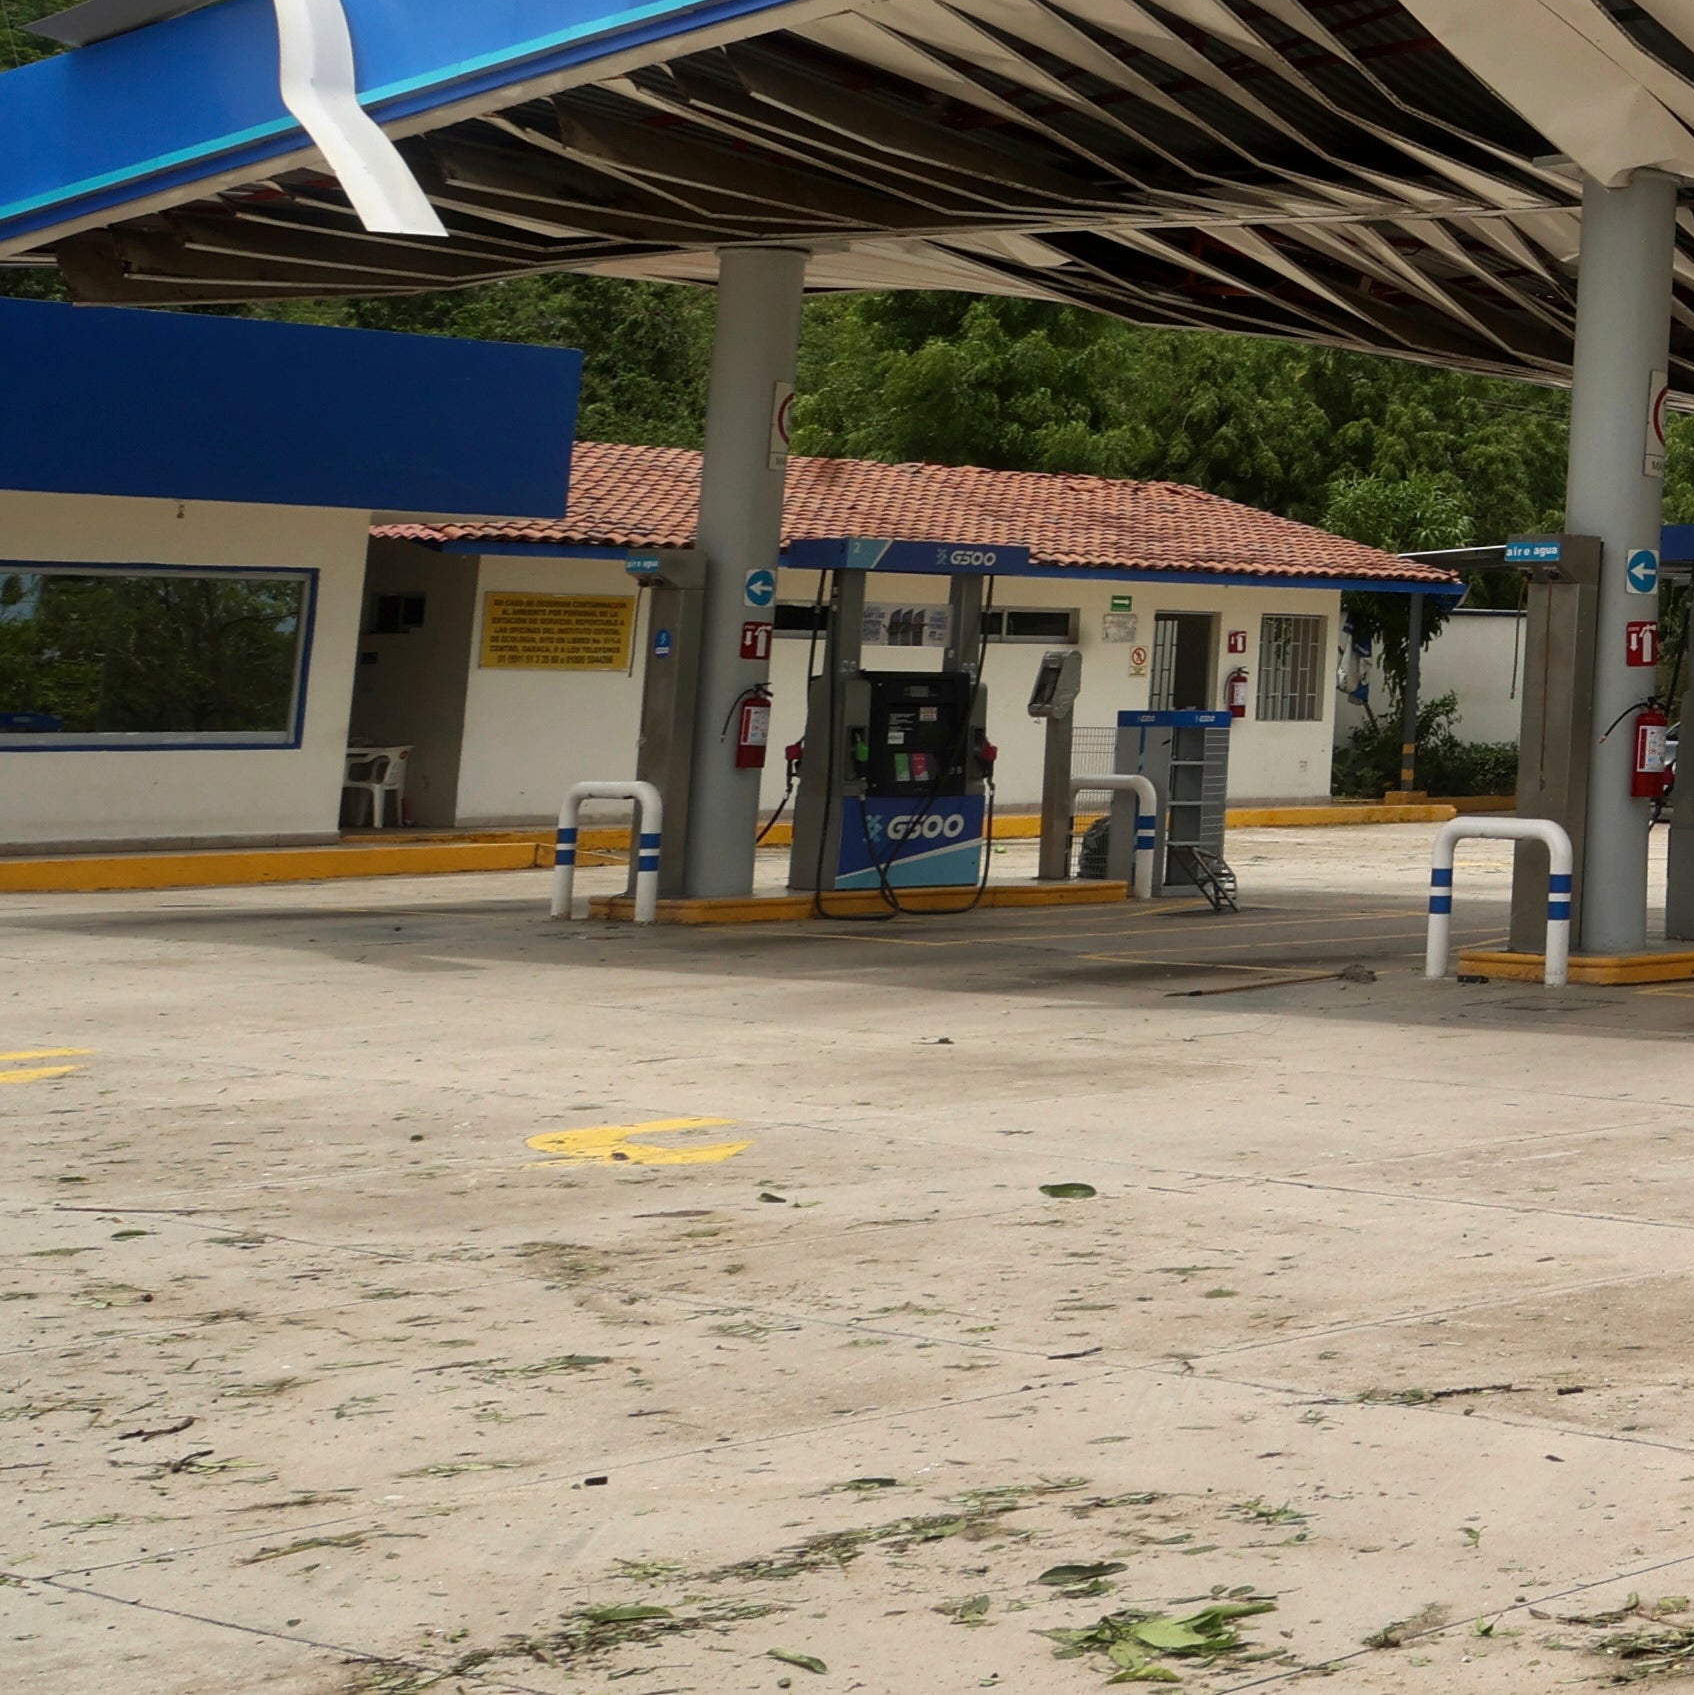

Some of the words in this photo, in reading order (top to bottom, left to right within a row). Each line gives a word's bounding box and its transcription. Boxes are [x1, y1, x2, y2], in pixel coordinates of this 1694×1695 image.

[951, 549, 996, 566] G500
[1506, 546, 1531, 556] aire
[1533, 546, 1558, 557] agua
[887, 814, 964, 840] G500
